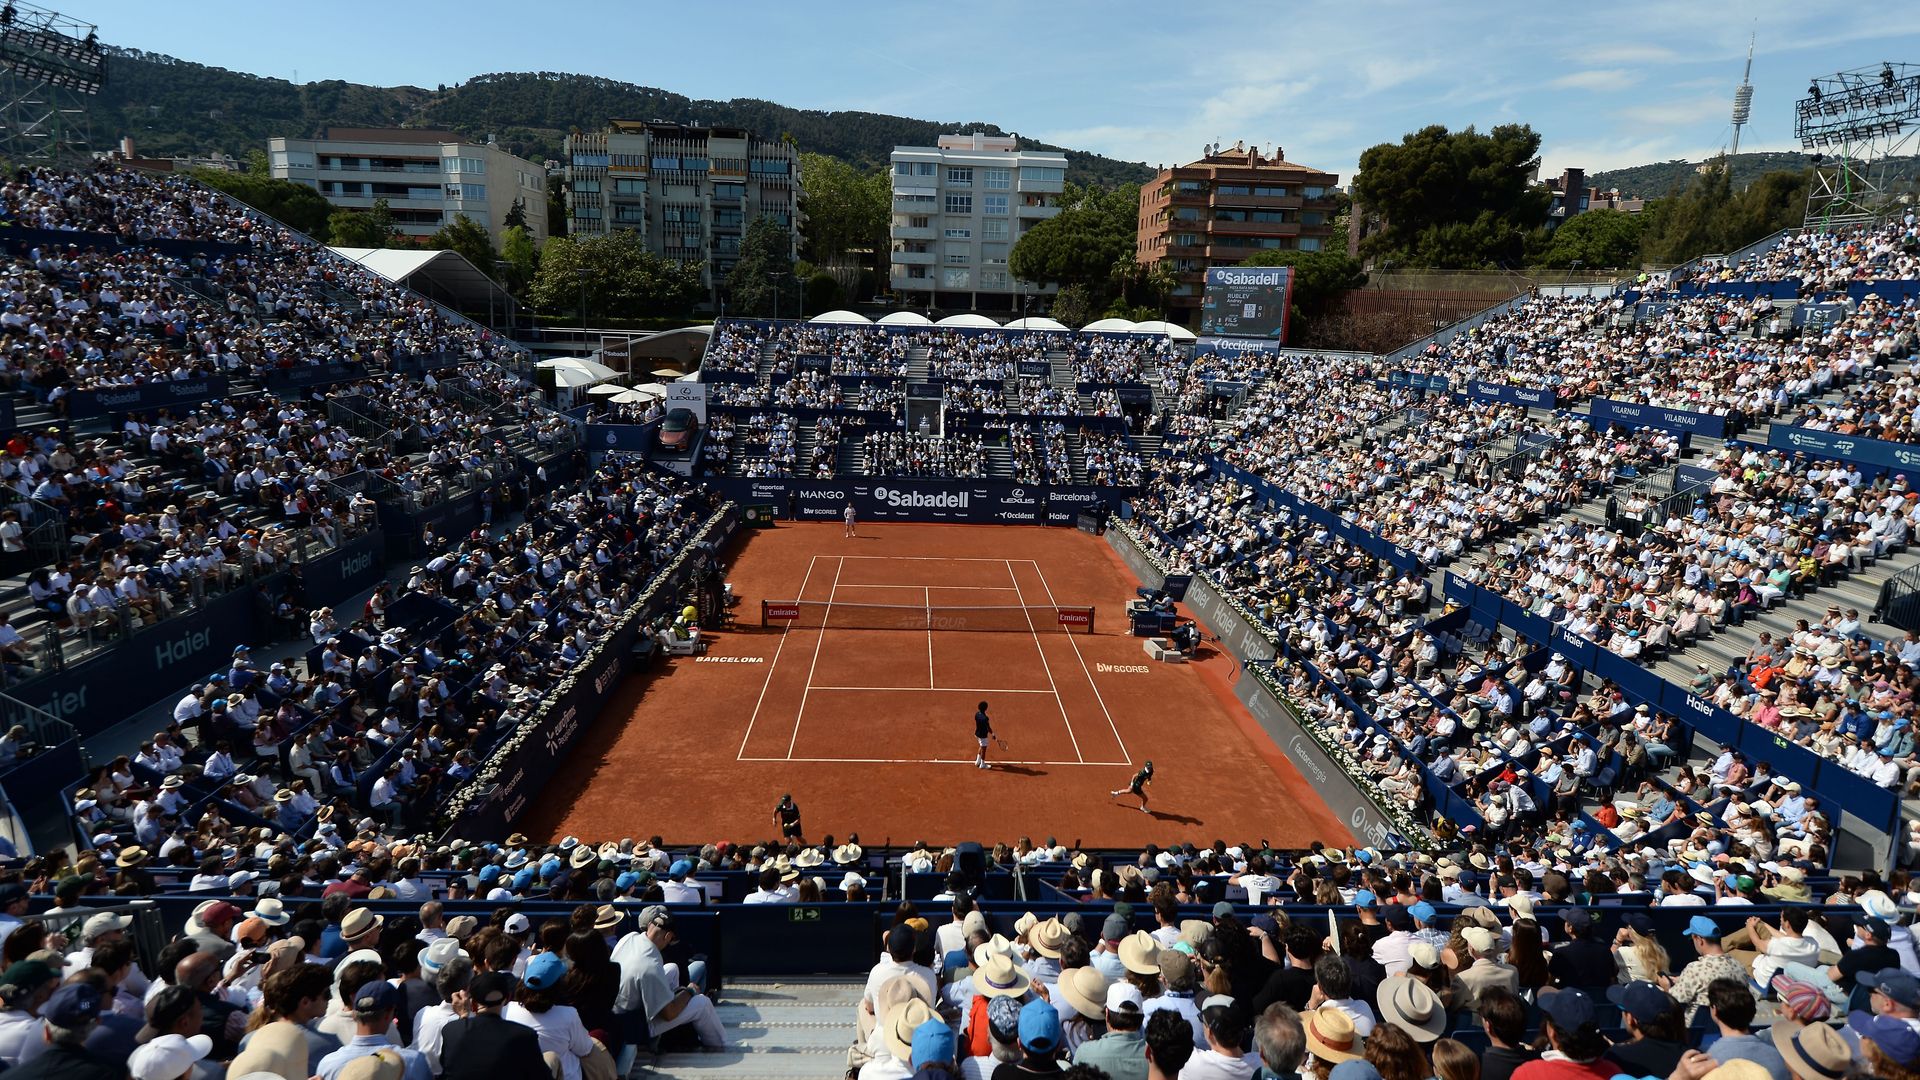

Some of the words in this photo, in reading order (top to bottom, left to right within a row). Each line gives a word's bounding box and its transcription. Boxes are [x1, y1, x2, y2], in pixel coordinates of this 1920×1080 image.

[1224, 272, 1279, 286] Sabadell
[1221, 340, 1264, 351] Occident
[802, 357, 826, 366] Haier
[1022, 364, 1045, 373] Haier
[1480, 385, 1499, 396] Sabadell
[1517, 391, 1540, 402] Sabadell
[1611, 405, 1641, 417] VILARNAU
[1664, 413, 1697, 425] VILARNAU
[1833, 440, 1855, 450] ATP
[800, 490, 845, 499] MANGO
[887, 489, 969, 508] Sabadell
[1049, 492, 1090, 502] Barcelona
[1048, 512, 1070, 520] Haier
[341, 549, 373, 580] Haier
[1452, 576, 1468, 590] Haier
[768, 608, 798, 616] Emirates
[1186, 579, 1211, 609] Haier
[1212, 602, 1237, 637] Haier
[932, 616, 967, 629] TOUR
[1060, 613, 1088, 622] Emirates
[1563, 631, 1585, 649] Haier
[155, 626, 211, 671] Haier
[1096, 662, 1113, 673] bw
[1114, 665, 1150, 674] SCORES
[1687, 694, 1715, 717] Haier
[1363, 820, 1392, 850] VEOLI
